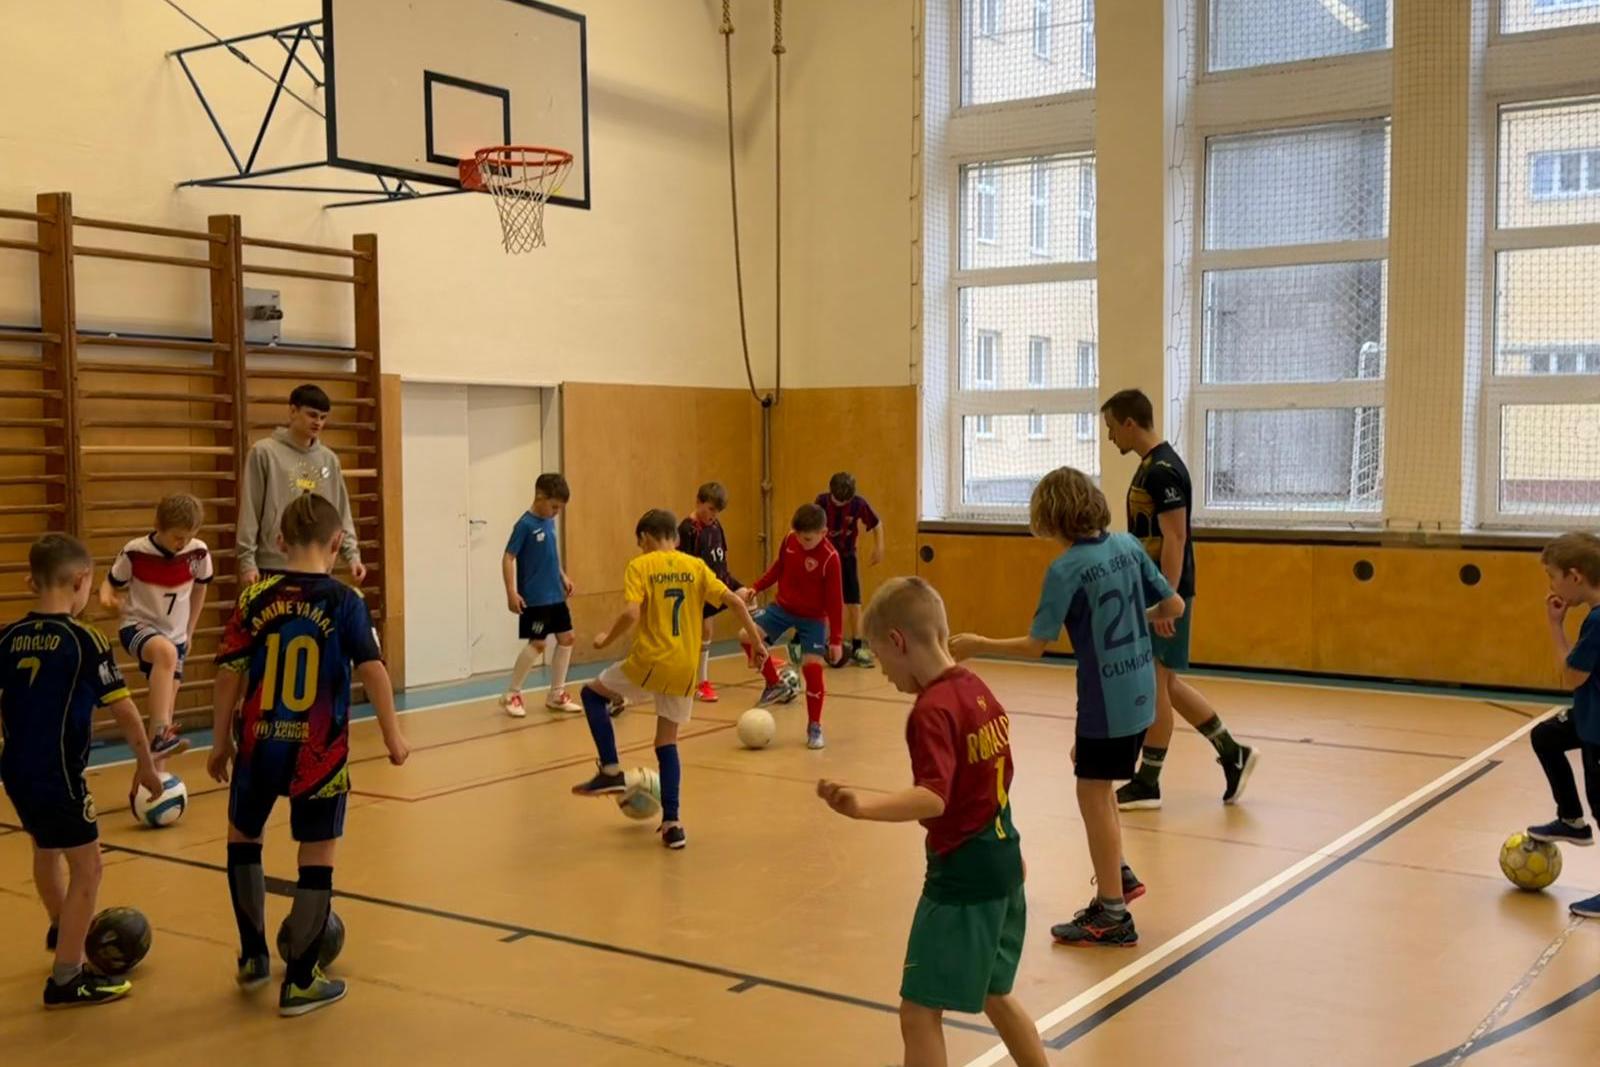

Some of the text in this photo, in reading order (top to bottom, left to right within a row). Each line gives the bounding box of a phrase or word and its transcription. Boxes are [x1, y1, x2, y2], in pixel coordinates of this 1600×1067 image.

[711, 547, 724, 562] 19
[163, 592, 178, 616] 7
[664, 587, 686, 637] 7
[1099, 581, 1149, 651] 21
[16, 656, 41, 689] 7
[260, 632, 320, 712] 10
